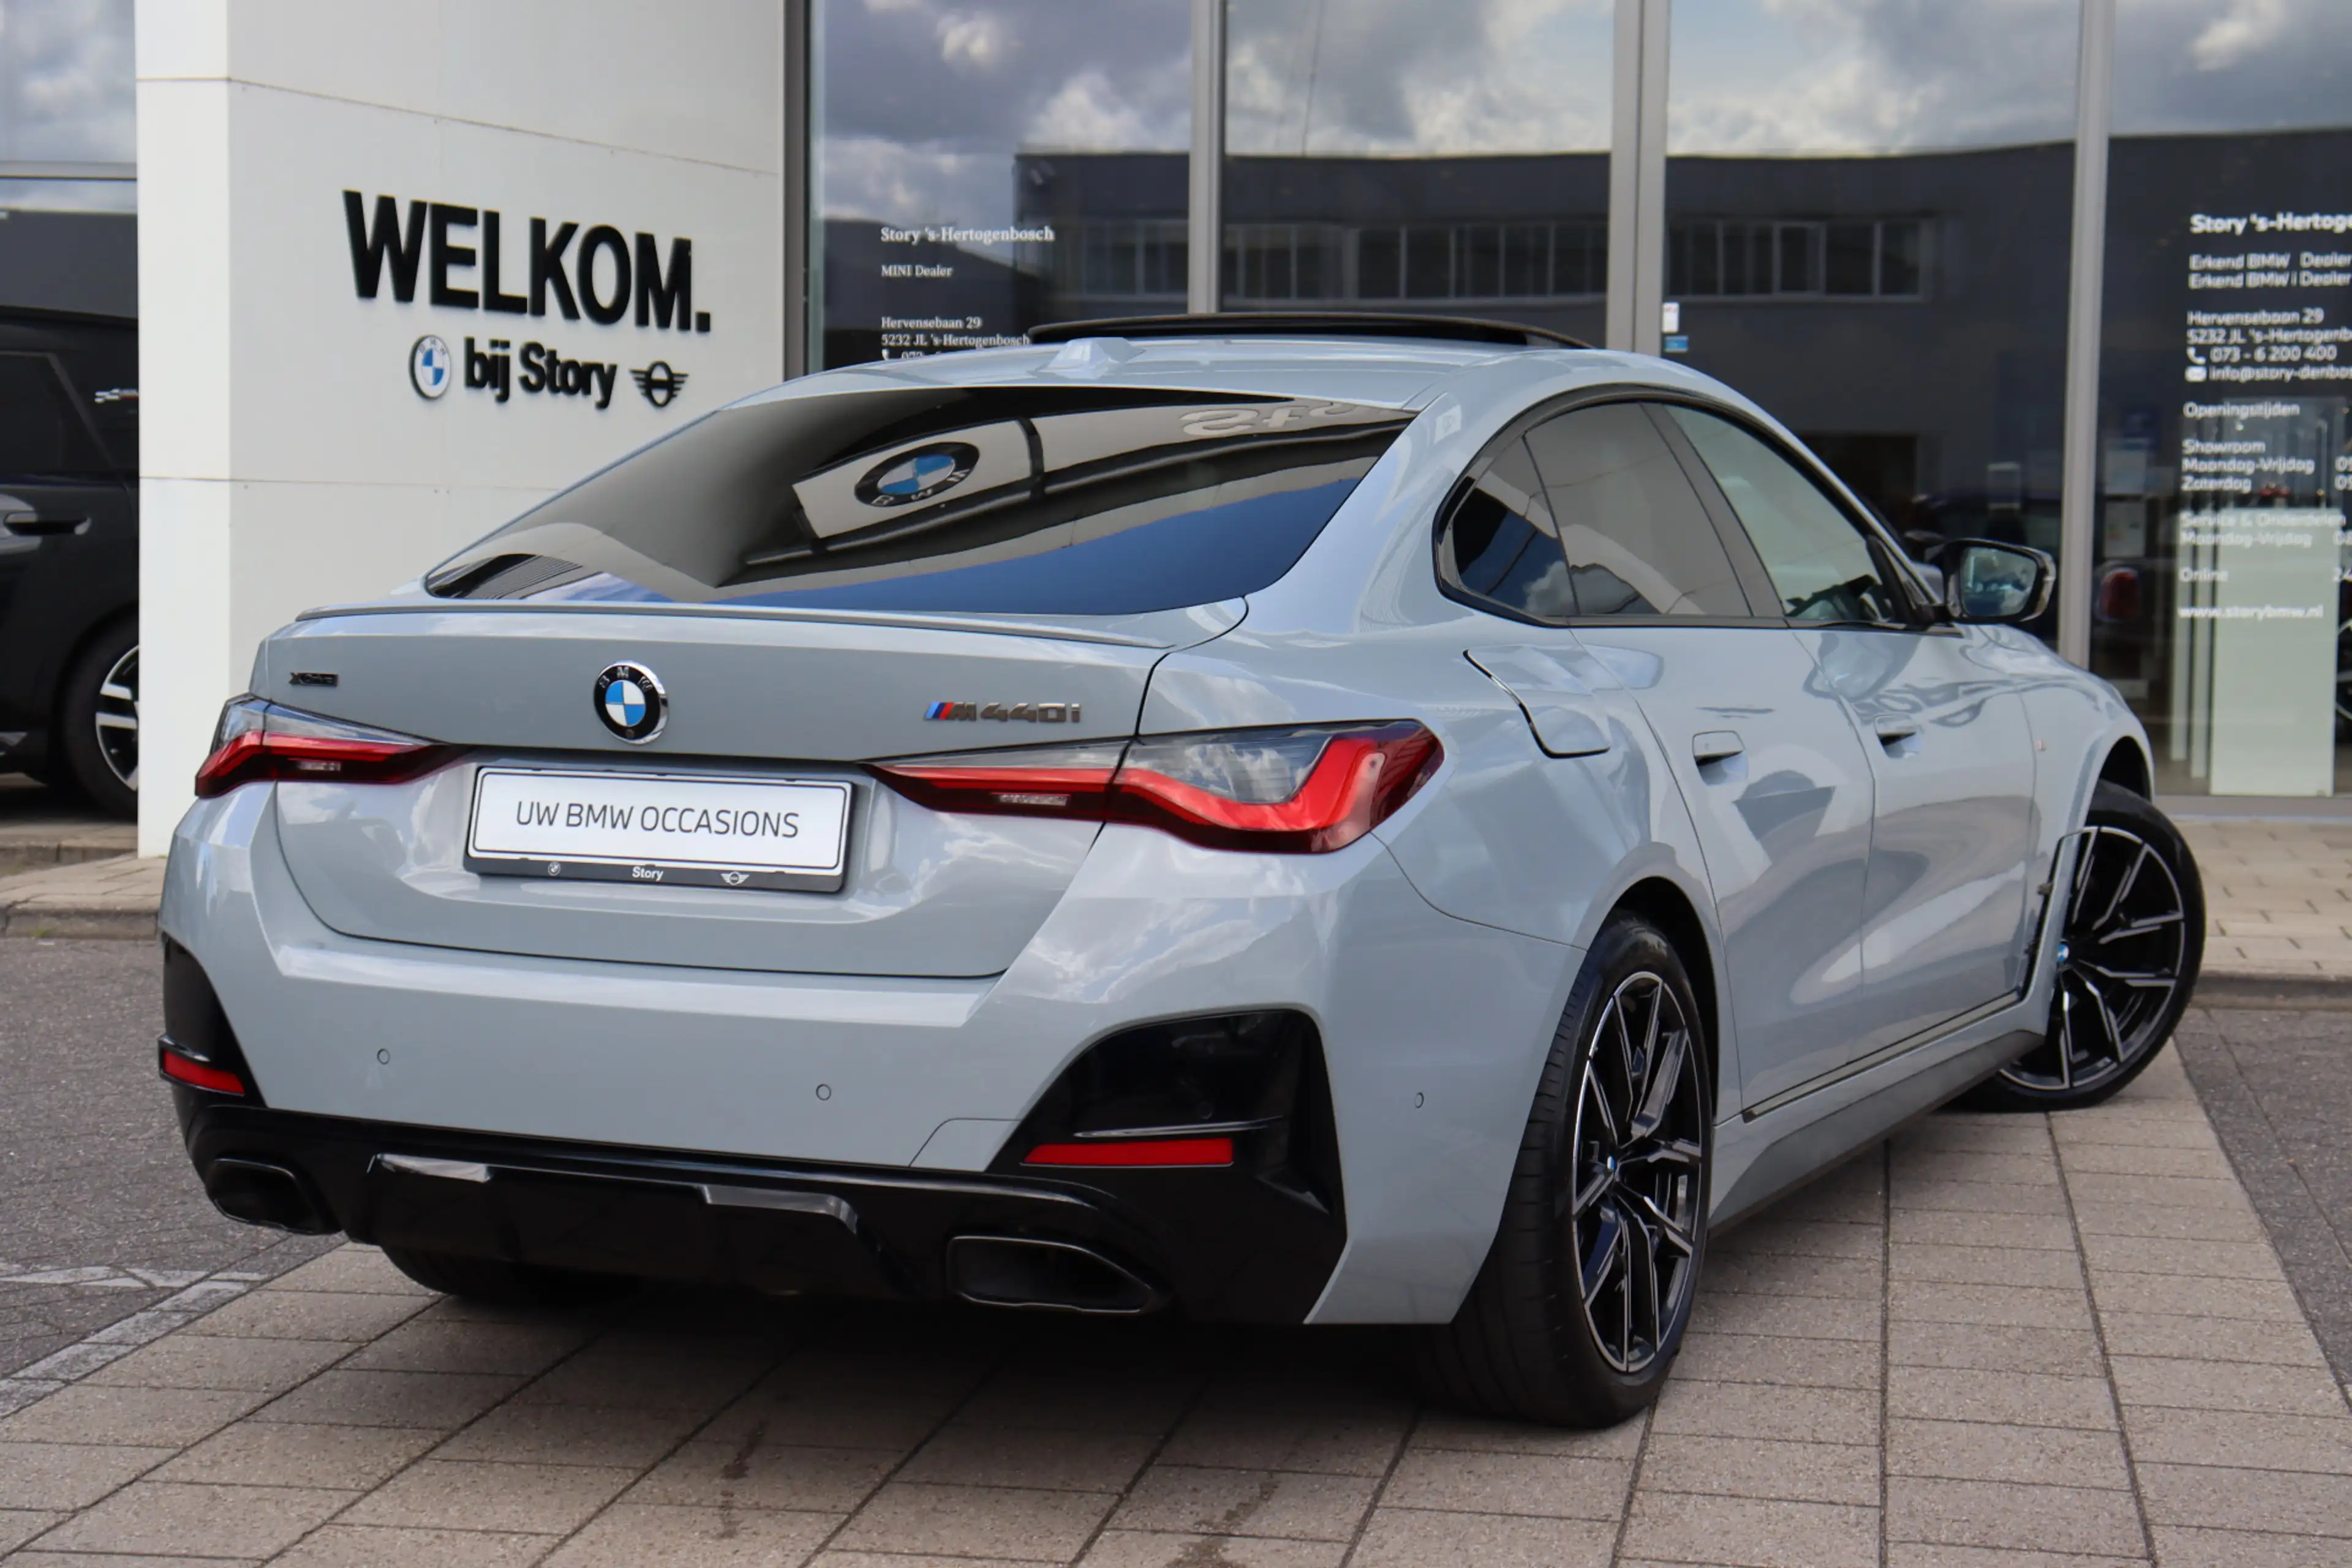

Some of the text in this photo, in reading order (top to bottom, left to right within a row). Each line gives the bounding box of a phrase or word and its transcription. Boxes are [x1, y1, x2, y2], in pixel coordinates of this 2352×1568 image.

[2190, 214, 2247, 236] Story
[881, 225, 1055, 245] Story 's-Hertogenbosch
[342, 189, 710, 333] WELKOM.
[2188, 252, 2352, 270] Erkend BMW Dealer
[881, 265, 952, 277] MINI Dealer
[2188, 273, 2244, 289] Erkend
[2245, 272, 2290, 287] BMW
[2299, 270, 2351, 287] Dealer
[881, 317, 981, 329] Hervensebaan 29
[2301, 307, 2324, 324] 29
[881, 333, 910, 347] 5232
[913, 334, 928, 346] JL
[2187, 328, 2226, 344] 5232
[2209, 347, 2241, 362] 073
[2253, 347, 2266, 361] 6
[2267, 347, 2301, 361] 200
[2303, 345, 2337, 361] 400
[464, 336, 617, 409] bij Story
[2182, 440, 2266, 454] Showroom
[2181, 476, 2252, 493] Zaterdag
[516, 802, 799, 839] UW BMW OCCASIONS
[631, 865, 664, 882] Story
